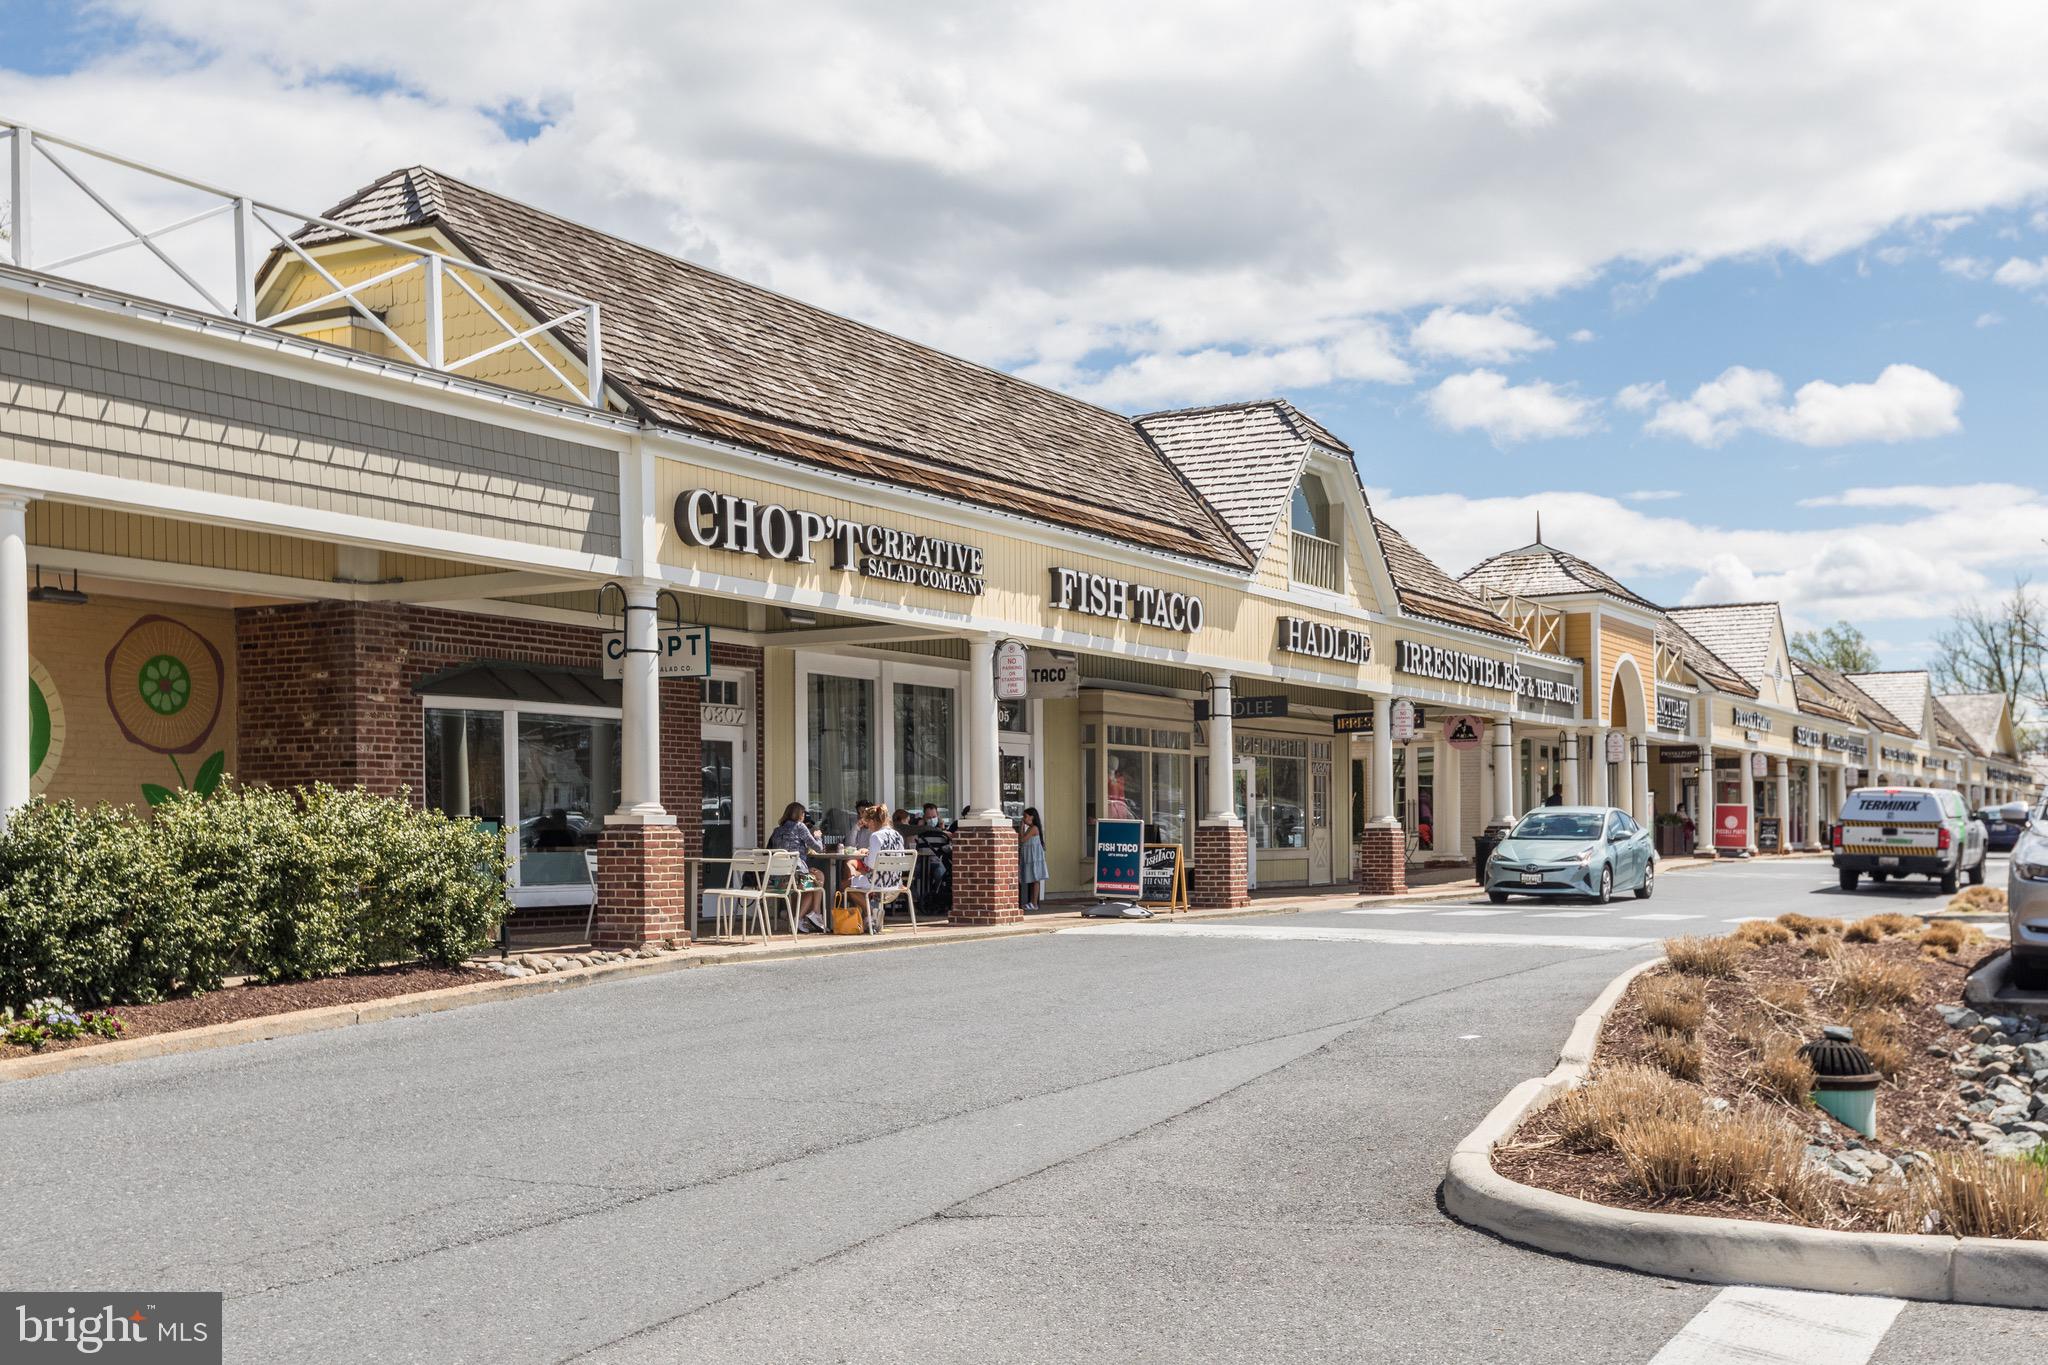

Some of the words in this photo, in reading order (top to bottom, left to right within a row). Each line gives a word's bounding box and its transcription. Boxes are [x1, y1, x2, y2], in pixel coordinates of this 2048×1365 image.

[679, 487, 863, 572] CHOP'T
[866, 524, 985, 576] CREATIVE
[866, 557, 918, 584] SALAD
[919, 567, 987, 597] COMPANY
[1054, 567, 1129, 620] FISH
[1135, 585, 1204, 633] TACO
[1283, 615, 1371, 665] HADLEE
[1400, 640, 1520, 693] IRRESISTIBLES
[1535, 679, 1555, 700] THE
[1555, 682, 1580, 704] JUICE
[1859, 800, 1920, 811] TERMINIX
[1098, 843, 1116, 852] FISH
[1117, 843, 1138, 853] TACO
